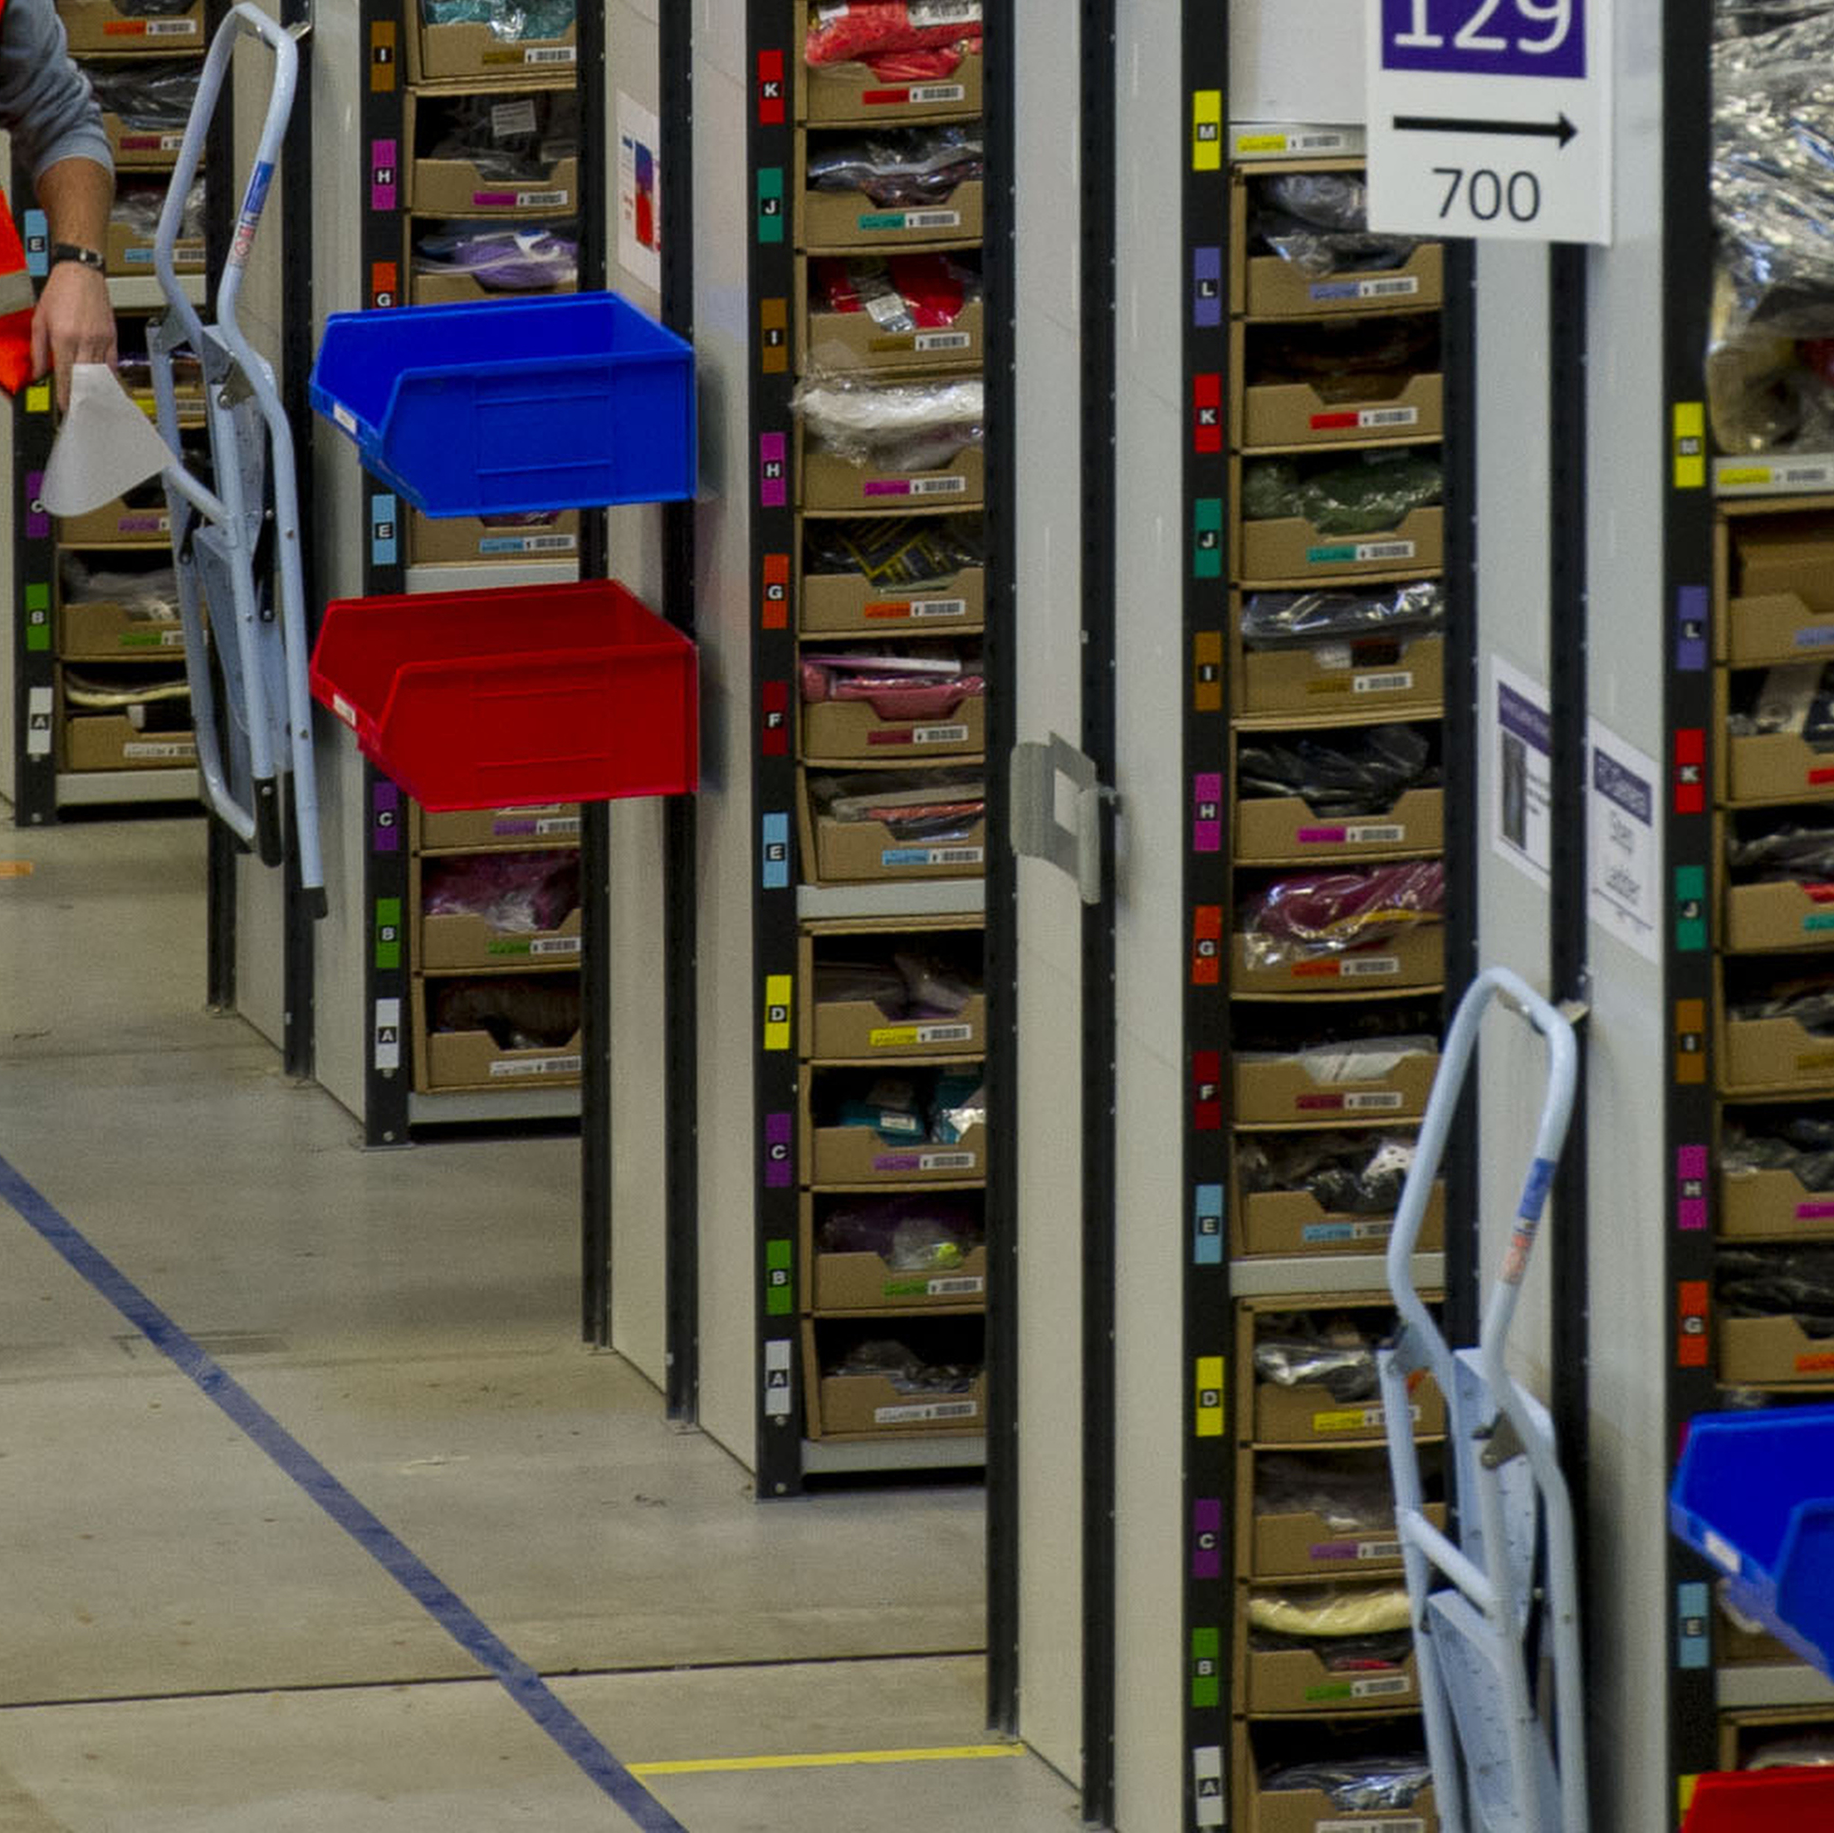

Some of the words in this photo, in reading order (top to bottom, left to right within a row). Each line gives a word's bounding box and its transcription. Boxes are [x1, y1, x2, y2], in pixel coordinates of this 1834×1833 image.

[380, 48, 386, 61] I
[765, 83, 777, 97] K
[1200, 126, 1214, 138] M
[378, 170, 390, 182] H
[1433, 168, 1540, 222] 700
[765, 200, 775, 214] J
[31, 238, 41, 251] E
[1202, 282, 1214, 296] L
[377, 293, 391, 306] G
[771, 330, 777, 344] I
[1202, 410, 1214, 423] K
[767, 464, 780, 477] H
[379, 524, 390, 538] E
[1202, 533, 1213, 548] J
[768, 585, 782, 599] G
[31, 611, 44, 624] B
[1205, 666, 1211, 680] I
[34, 716, 46, 728] A
[769, 713, 780, 727] F
[1201, 804, 1215, 818] H
[379, 812, 392, 826] C
[770, 845, 781, 859] E
[382, 927, 394, 940] B
[1199, 941, 1213, 955] G
[771, 1007, 785, 1020] D
[381, 1029, 393, 1042] A
[1201, 1085, 1213, 1099] F
[772, 1145, 785, 1159] C
[1203, 1218, 1214, 1233] E
[773, 1271, 785, 1284] B
[772, 1372, 784, 1385] A
[1203, 1391, 1217, 1406] D
[1200, 1534, 1213, 1548] C
[1199, 1660, 1211, 1674] B
[1202, 1781, 1216, 1794] A
